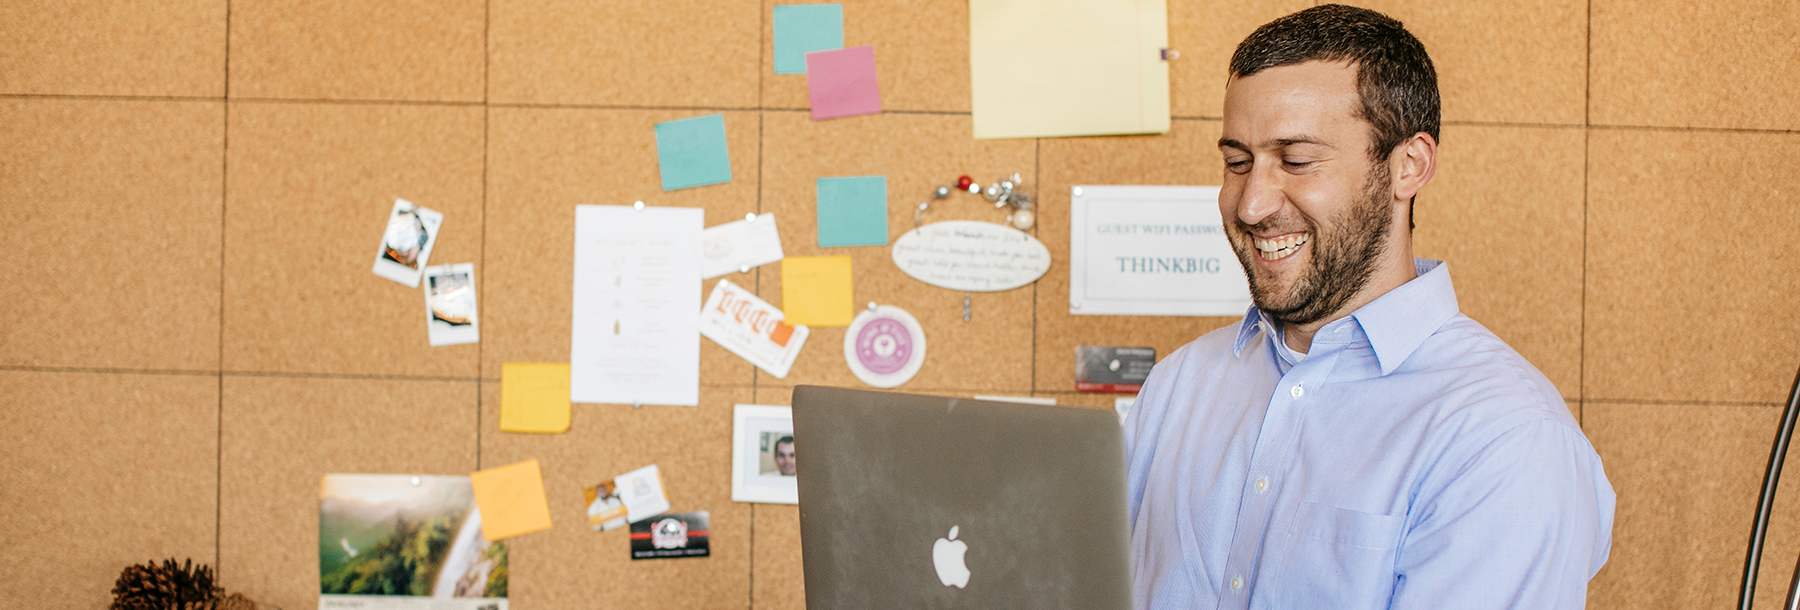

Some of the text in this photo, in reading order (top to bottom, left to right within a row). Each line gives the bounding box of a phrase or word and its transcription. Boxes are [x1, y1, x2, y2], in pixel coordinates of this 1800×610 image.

[1097, 224, 1224, 235] GUEST WIFI PASSWO
[1116, 256, 1221, 274] THINKBIG
